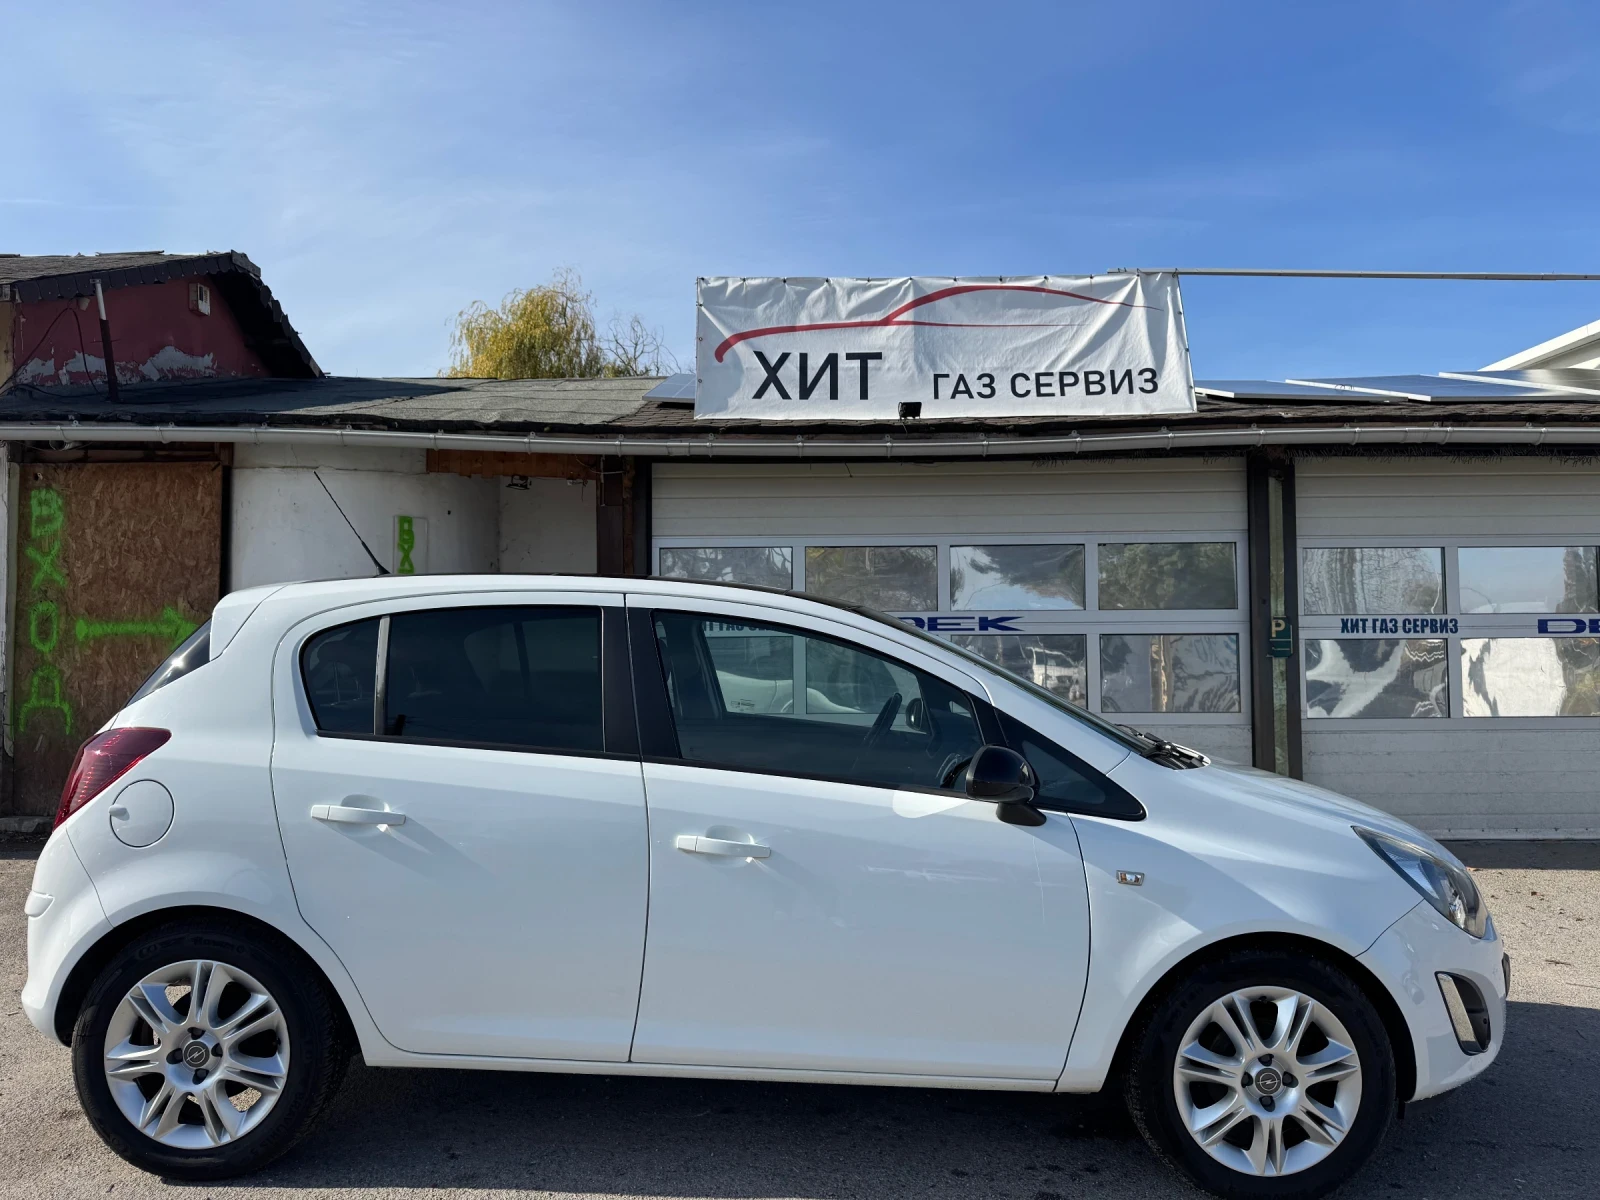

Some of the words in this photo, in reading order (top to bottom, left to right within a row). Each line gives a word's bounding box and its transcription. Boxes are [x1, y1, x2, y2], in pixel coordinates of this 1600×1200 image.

[752, 351, 882, 400] ХИТ
[932, 373, 996, 400] ГАЗ
[1009, 367, 1159, 398] СЕРВИЗ
[20, 487, 74, 734] ВХОД
[1271, 619, 1286, 638] P
[1340, 618, 1368, 634] ХИТ
[1372, 618, 1398, 634] ГАЗ
[1402, 618, 1459, 634] СЕРВИЗ
[1537, 619, 1600, 634] D
